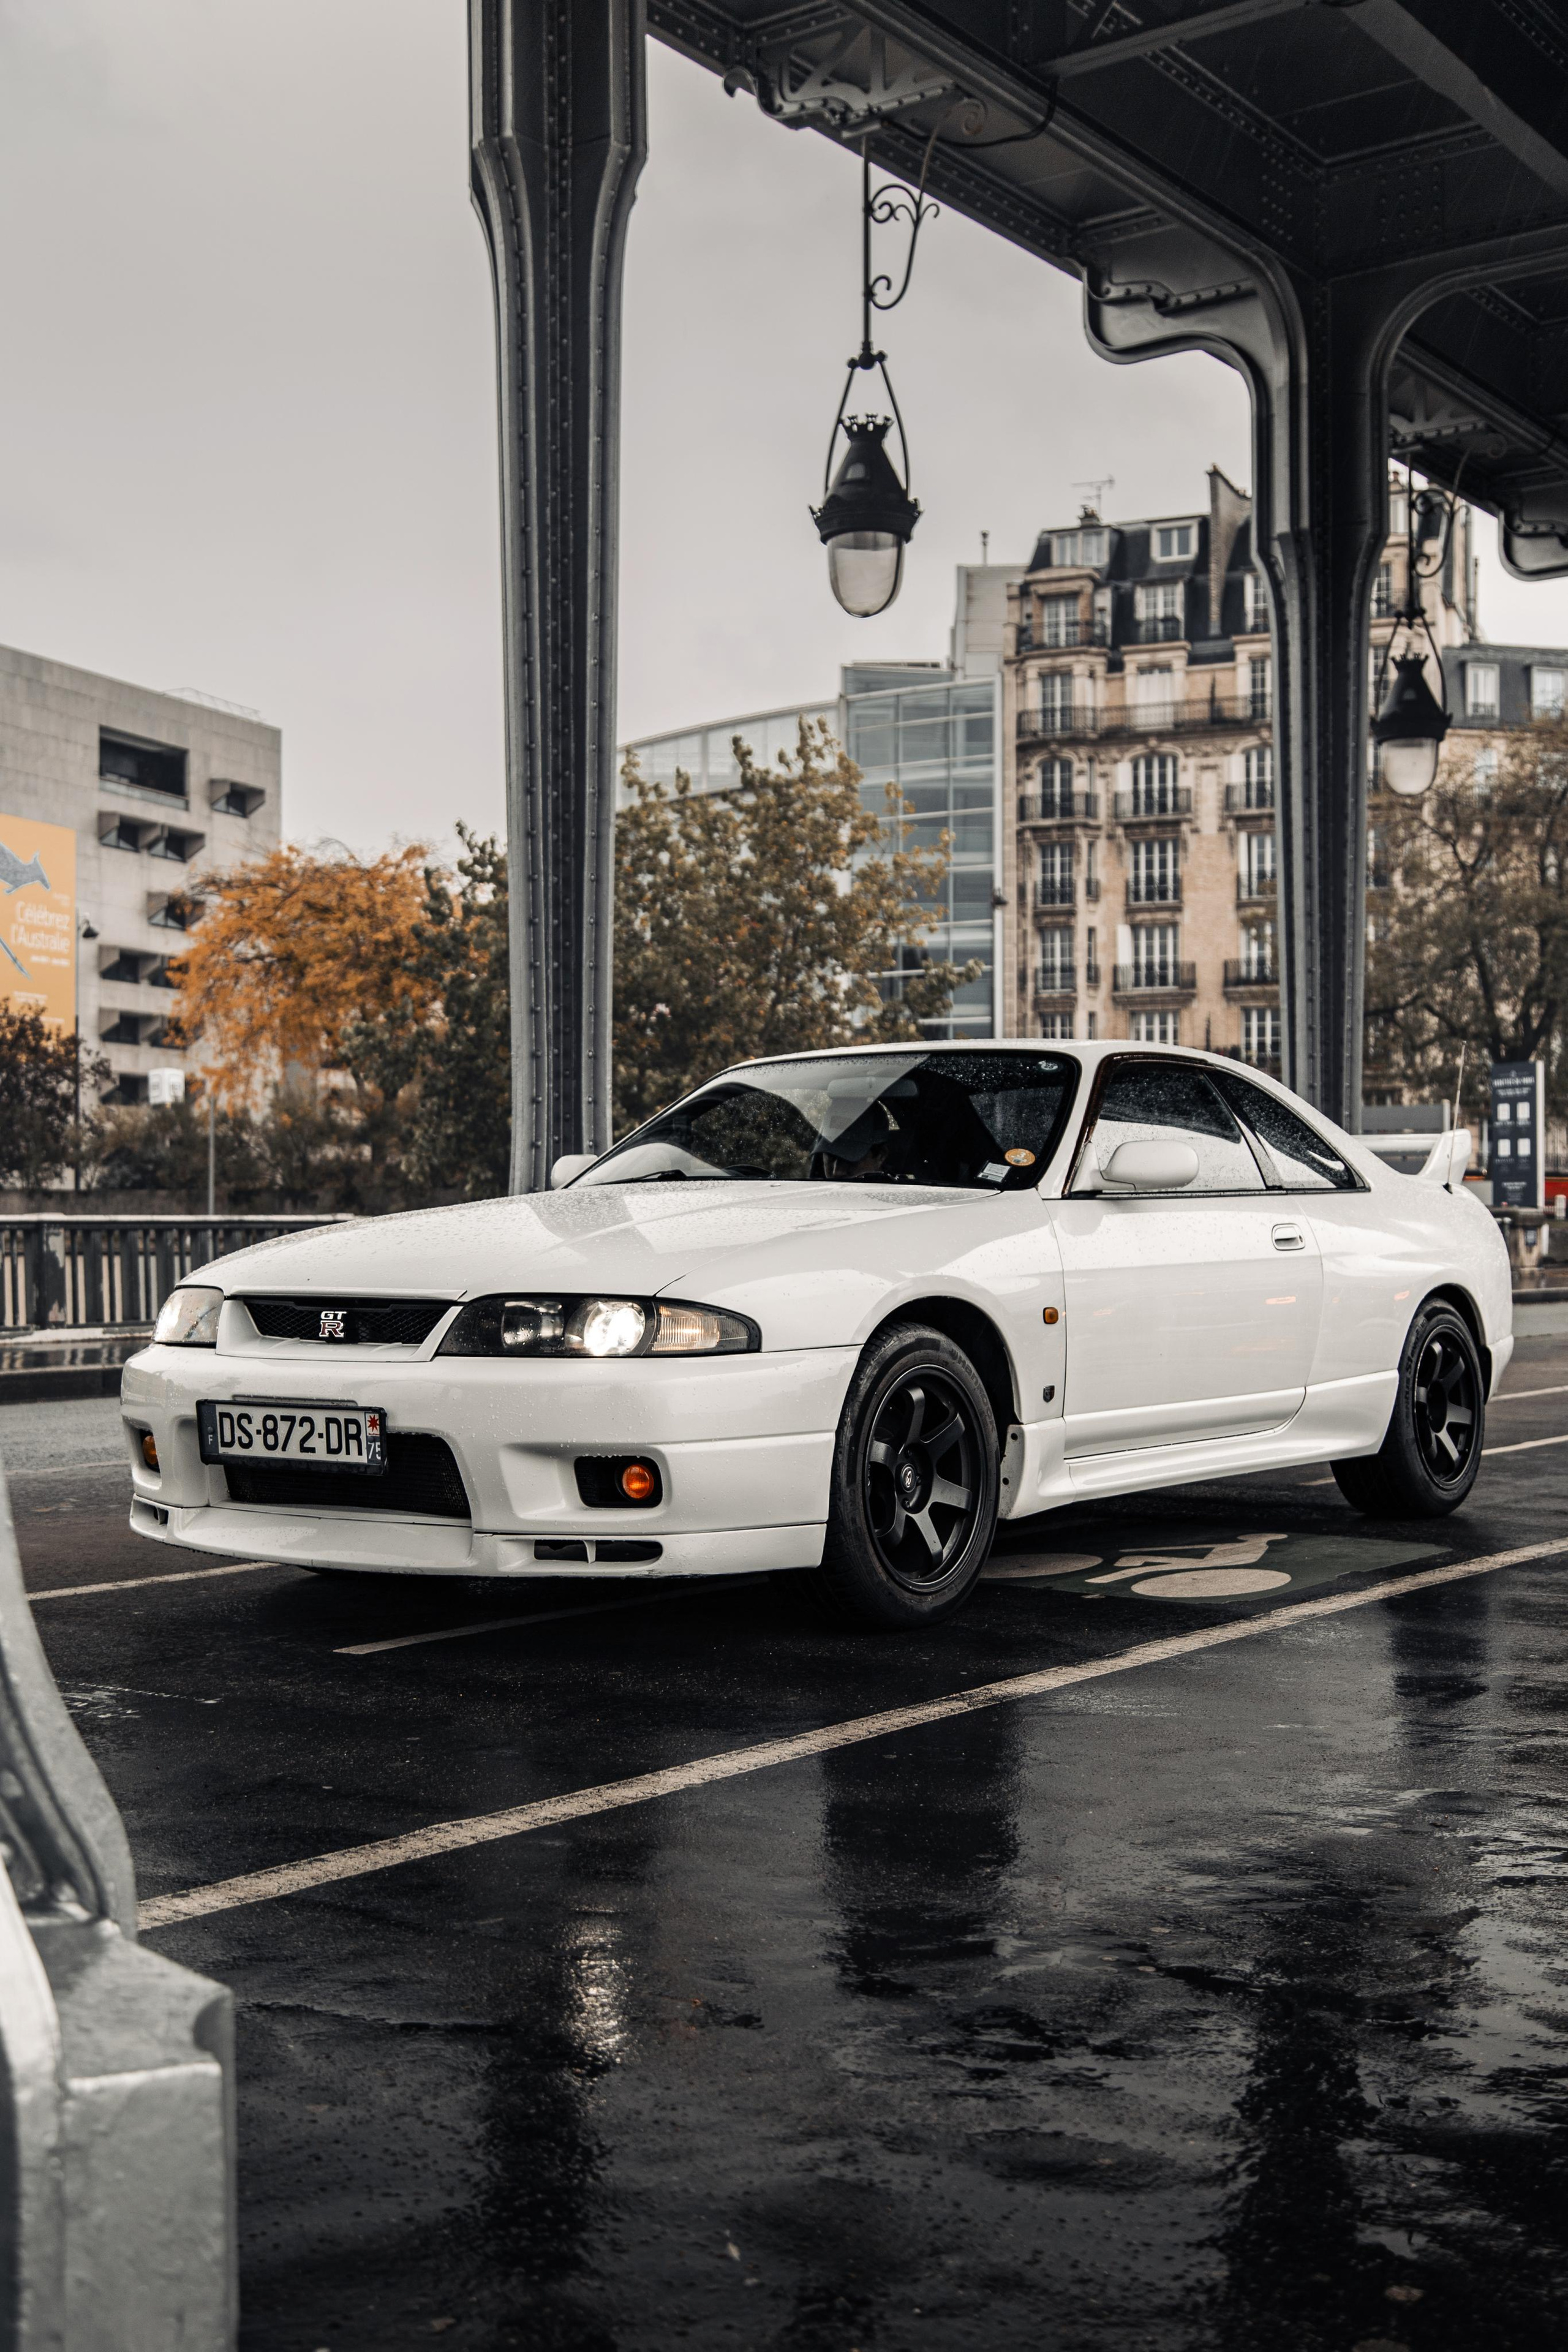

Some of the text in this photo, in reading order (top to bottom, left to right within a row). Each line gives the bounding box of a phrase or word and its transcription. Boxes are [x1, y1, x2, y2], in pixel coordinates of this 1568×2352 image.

[16, 900, 70, 930] Célébrez
[10, 923, 70, 954] l'Australie
[320, 1311, 347, 1320] GT
[319, 1320, 344, 1338] R
[208, 1434, 213, 1445] F
[219, 1411, 363, 1457] DS-872-DR
[368, 1442, 381, 1460] 75
